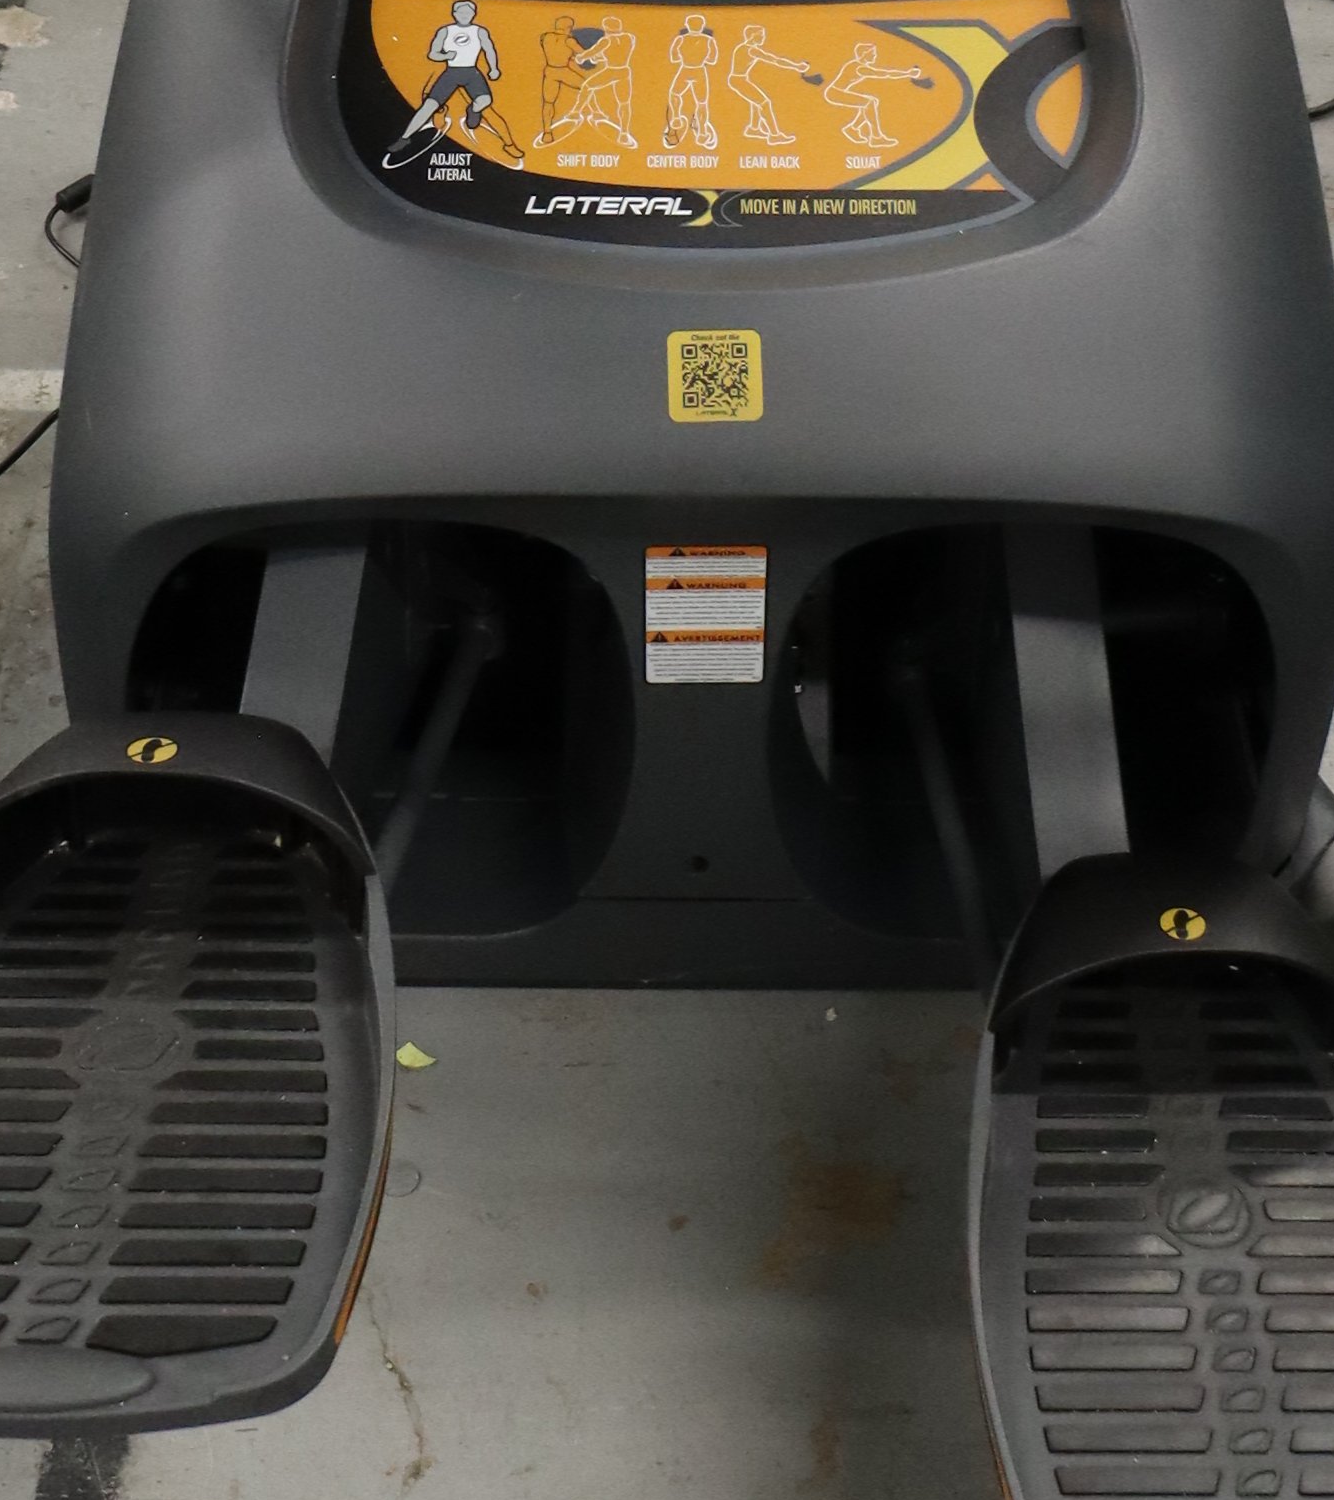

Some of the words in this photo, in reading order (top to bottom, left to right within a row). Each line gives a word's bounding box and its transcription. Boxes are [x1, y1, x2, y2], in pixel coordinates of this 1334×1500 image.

[429, 153, 473, 166] ADJUST
[556, 154, 588, 168] SHIFT
[591, 154, 620, 168] BODY
[646, 155, 687, 168] CENTER
[690, 155, 719, 169] BODY
[739, 155, 767, 169] LEAN
[770, 155, 800, 169] BACK
[845, 156, 881, 169] SQUAT
[427, 168, 474, 181] LATERAL
[740, 199, 779, 215] MOVE
[782, 199, 796, 215] IN
[799, 199, 811, 215] A
[813, 199, 846, 215] NEW
[849, 199, 917, 215] DIRECTION
